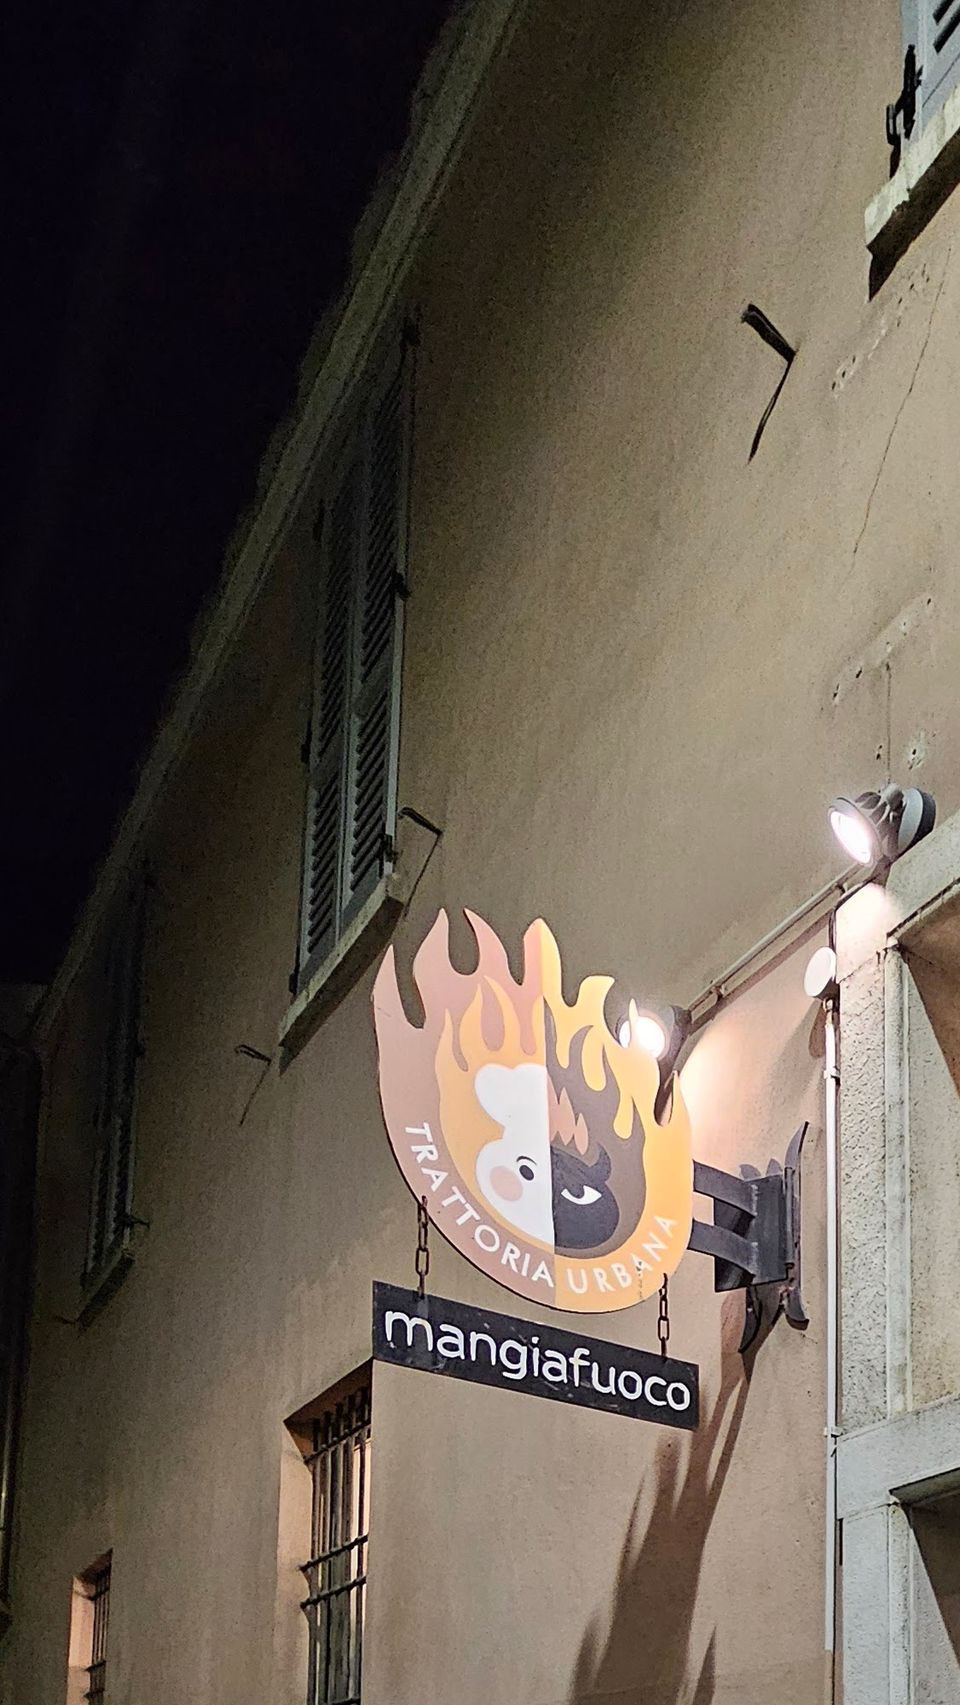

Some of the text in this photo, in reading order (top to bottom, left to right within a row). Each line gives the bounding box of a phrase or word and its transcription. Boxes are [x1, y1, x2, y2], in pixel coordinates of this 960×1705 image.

[404, 1120, 679, 1295] TRATTORIA URBANA
[384, 1307, 692, 1412] mangiafuoco
